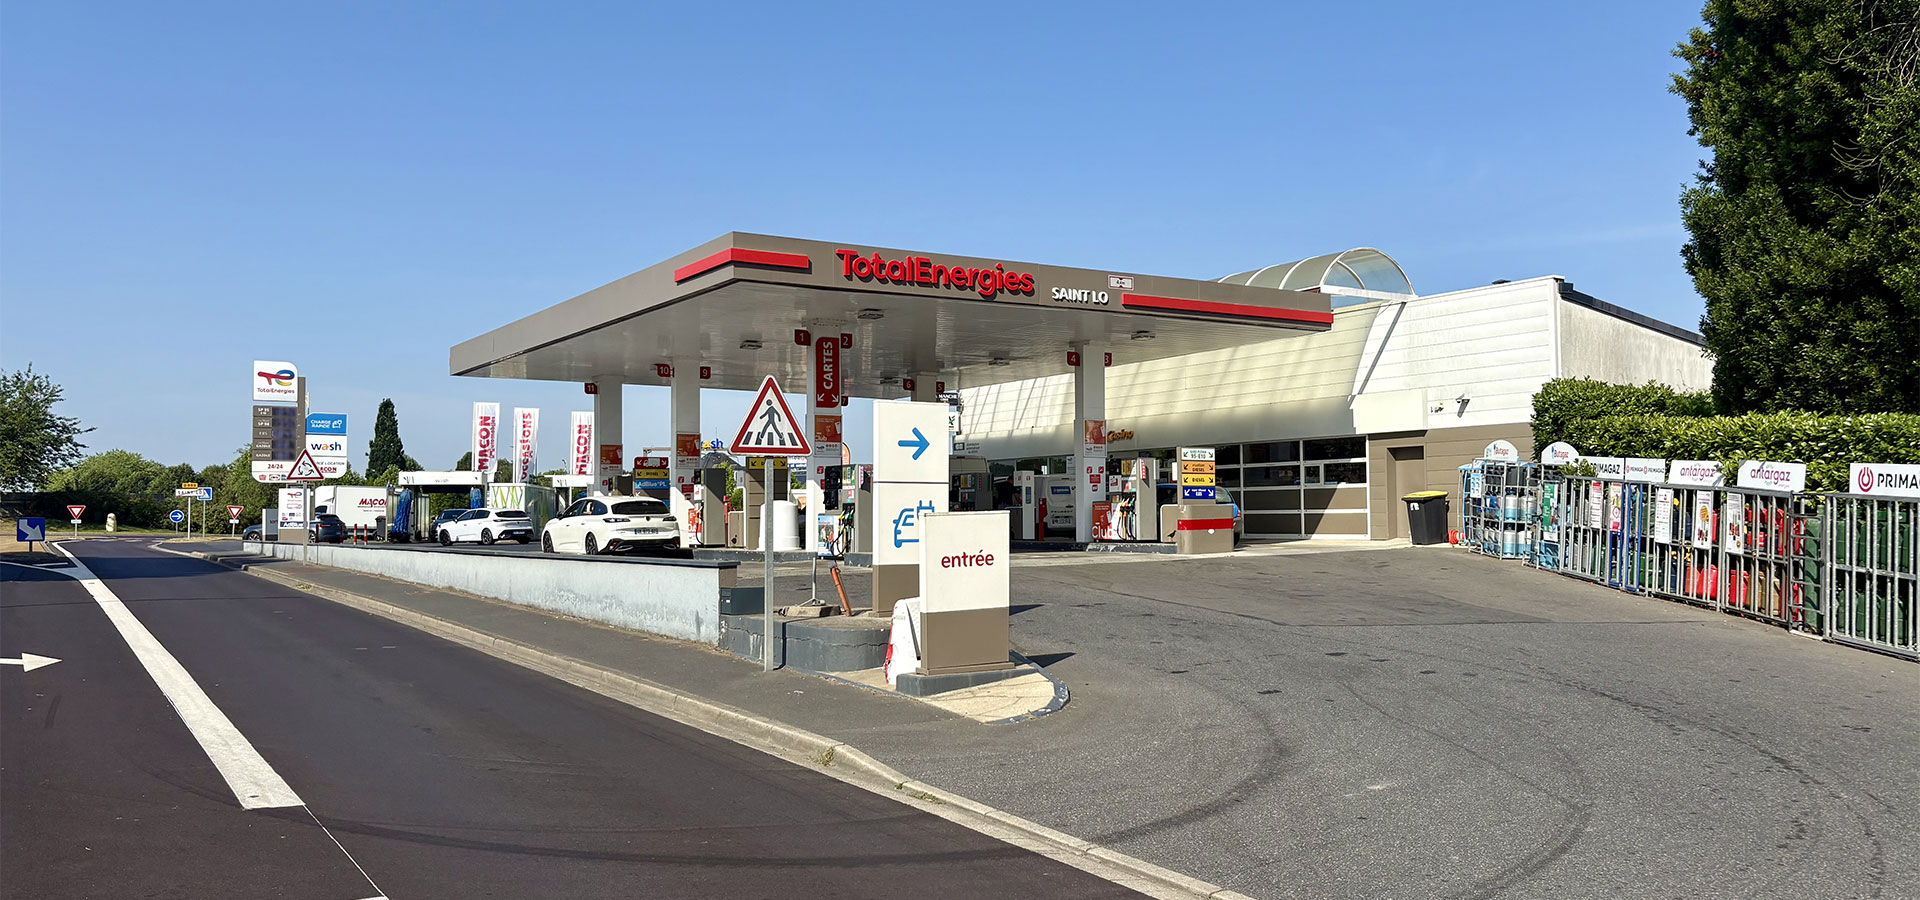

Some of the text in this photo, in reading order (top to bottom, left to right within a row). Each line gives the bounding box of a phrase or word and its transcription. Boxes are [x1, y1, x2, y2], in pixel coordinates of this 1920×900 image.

[836, 249, 1034, 297] TotalEnergies
[1052, 287, 1109, 304] SAINT LO
[800, 333, 804, 342] 1
[843, 336, 849, 346] 2
[823, 341, 833, 390] CARTES
[1071, 355, 1076, 363] 4
[1105, 355, 1109, 363] 3
[660, 366, 669, 375] 10
[1107, 429, 1135, 442] Casino
[311, 442, 341, 451] wash
[478, 416, 491, 470] MACON
[576, 424, 587, 475] MACON
[1495, 447, 1509, 456] Butagaz
[1554, 450, 1569, 459] Butagaz
[1680, 465, 1715, 481] antargaz
[1750, 468, 1791, 485] antargaz
[1877, 473, 1920, 489] PRIMA
[359, 498, 387, 507] MACO
[1092, 525, 1113, 539] Club
[941, 549, 995, 568] entrée
